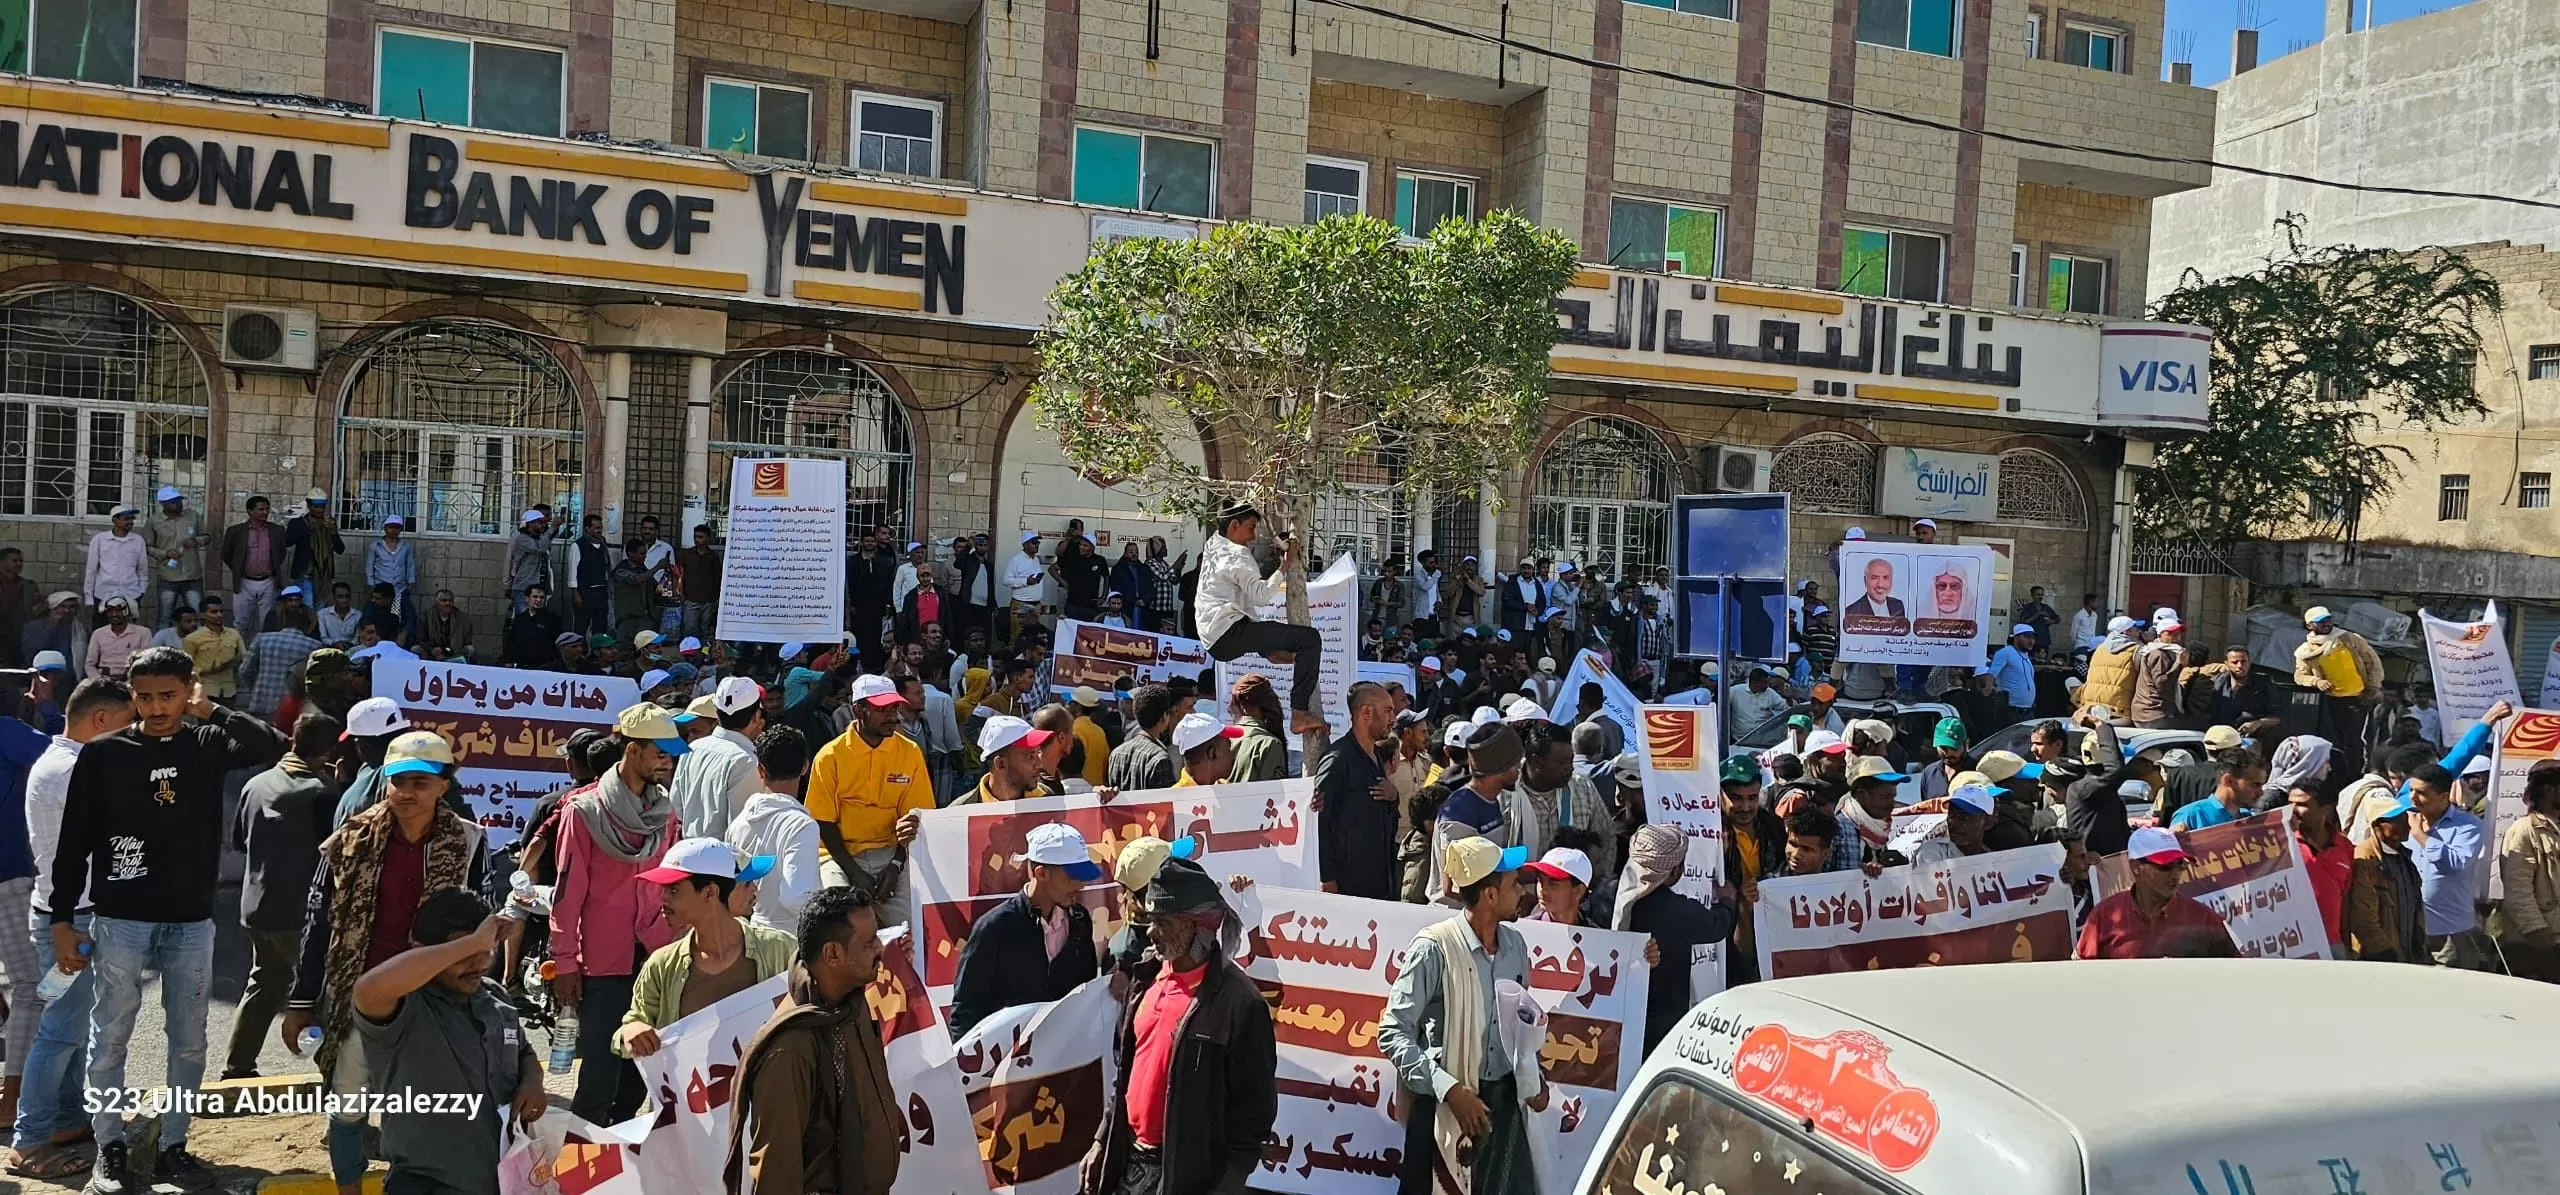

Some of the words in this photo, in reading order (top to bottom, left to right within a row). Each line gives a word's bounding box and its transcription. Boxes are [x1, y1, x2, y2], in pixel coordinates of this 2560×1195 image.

[405, 133, 608, 245] BANK
[626, 189, 713, 255] OF
[756, 174, 966, 315] YEMEN
[1663, 283, 1898, 397] اليمن
[1902, 311, 2021, 412] بنك
[2119, 361, 2197, 394] VISA
[404, 666, 487, 708] يحاول
[494, 681, 536, 710] من
[543, 677, 607, 711] هناك
[150, 767, 178, 782] NYC
[1672, 792, 1700, 811] عمال
[1789, 879, 1873, 933] أولادنا
[1878, 869, 1972, 926] وأقوات
[1974, 871, 2055, 907] حياتنا
[1232, 909, 1380, 970] نستنكر
